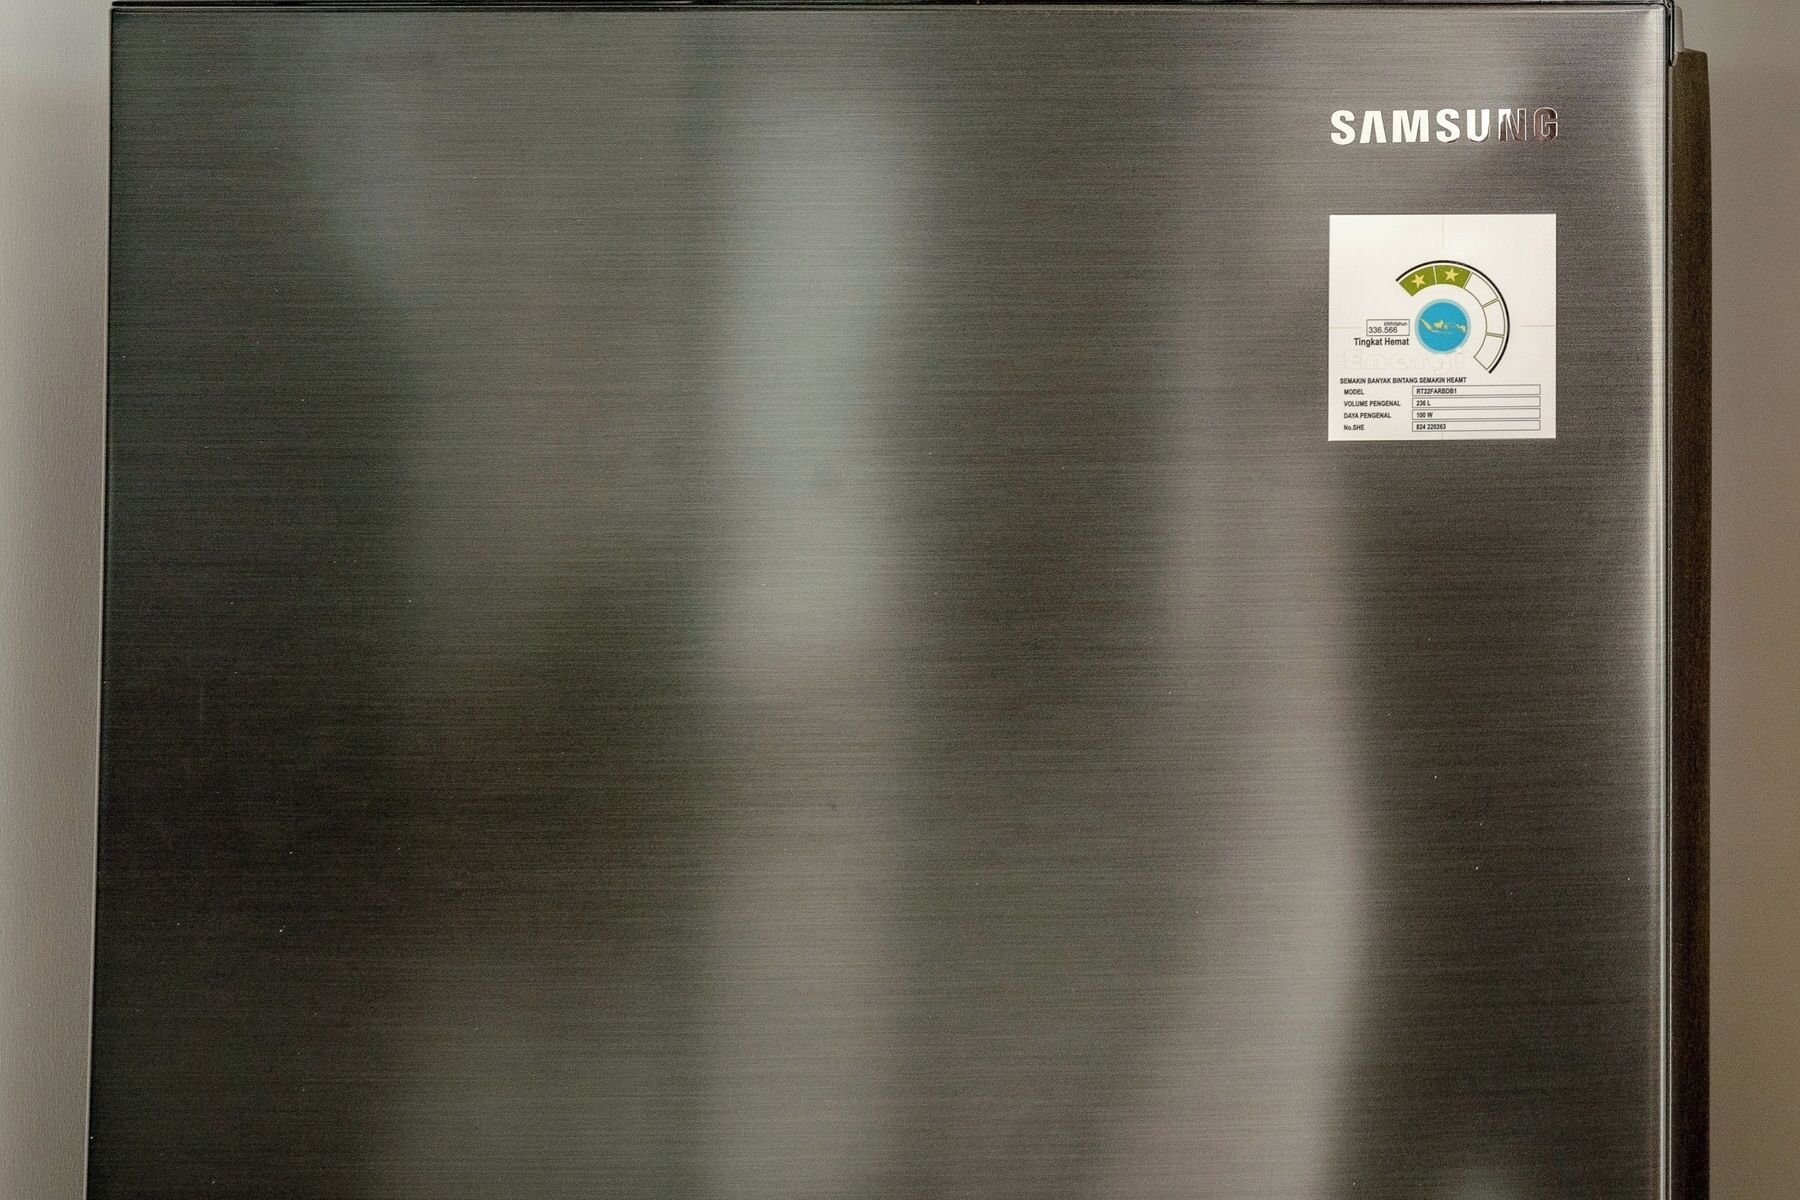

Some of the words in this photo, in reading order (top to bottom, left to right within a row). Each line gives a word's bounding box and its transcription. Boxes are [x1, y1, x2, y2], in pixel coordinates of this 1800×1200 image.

[1330, 107, 1559, 145] SAMSUNG
[1368, 326, 1398, 334] 336.566
[1353, 337, 1383, 348] Tingkat
[1384, 337, 1410, 346] Hemat
[1339, 377, 1367, 385] SEMAKIN
[1367, 377, 1391, 385] BANYAK
[1343, 388, 1365, 396] MODEL
